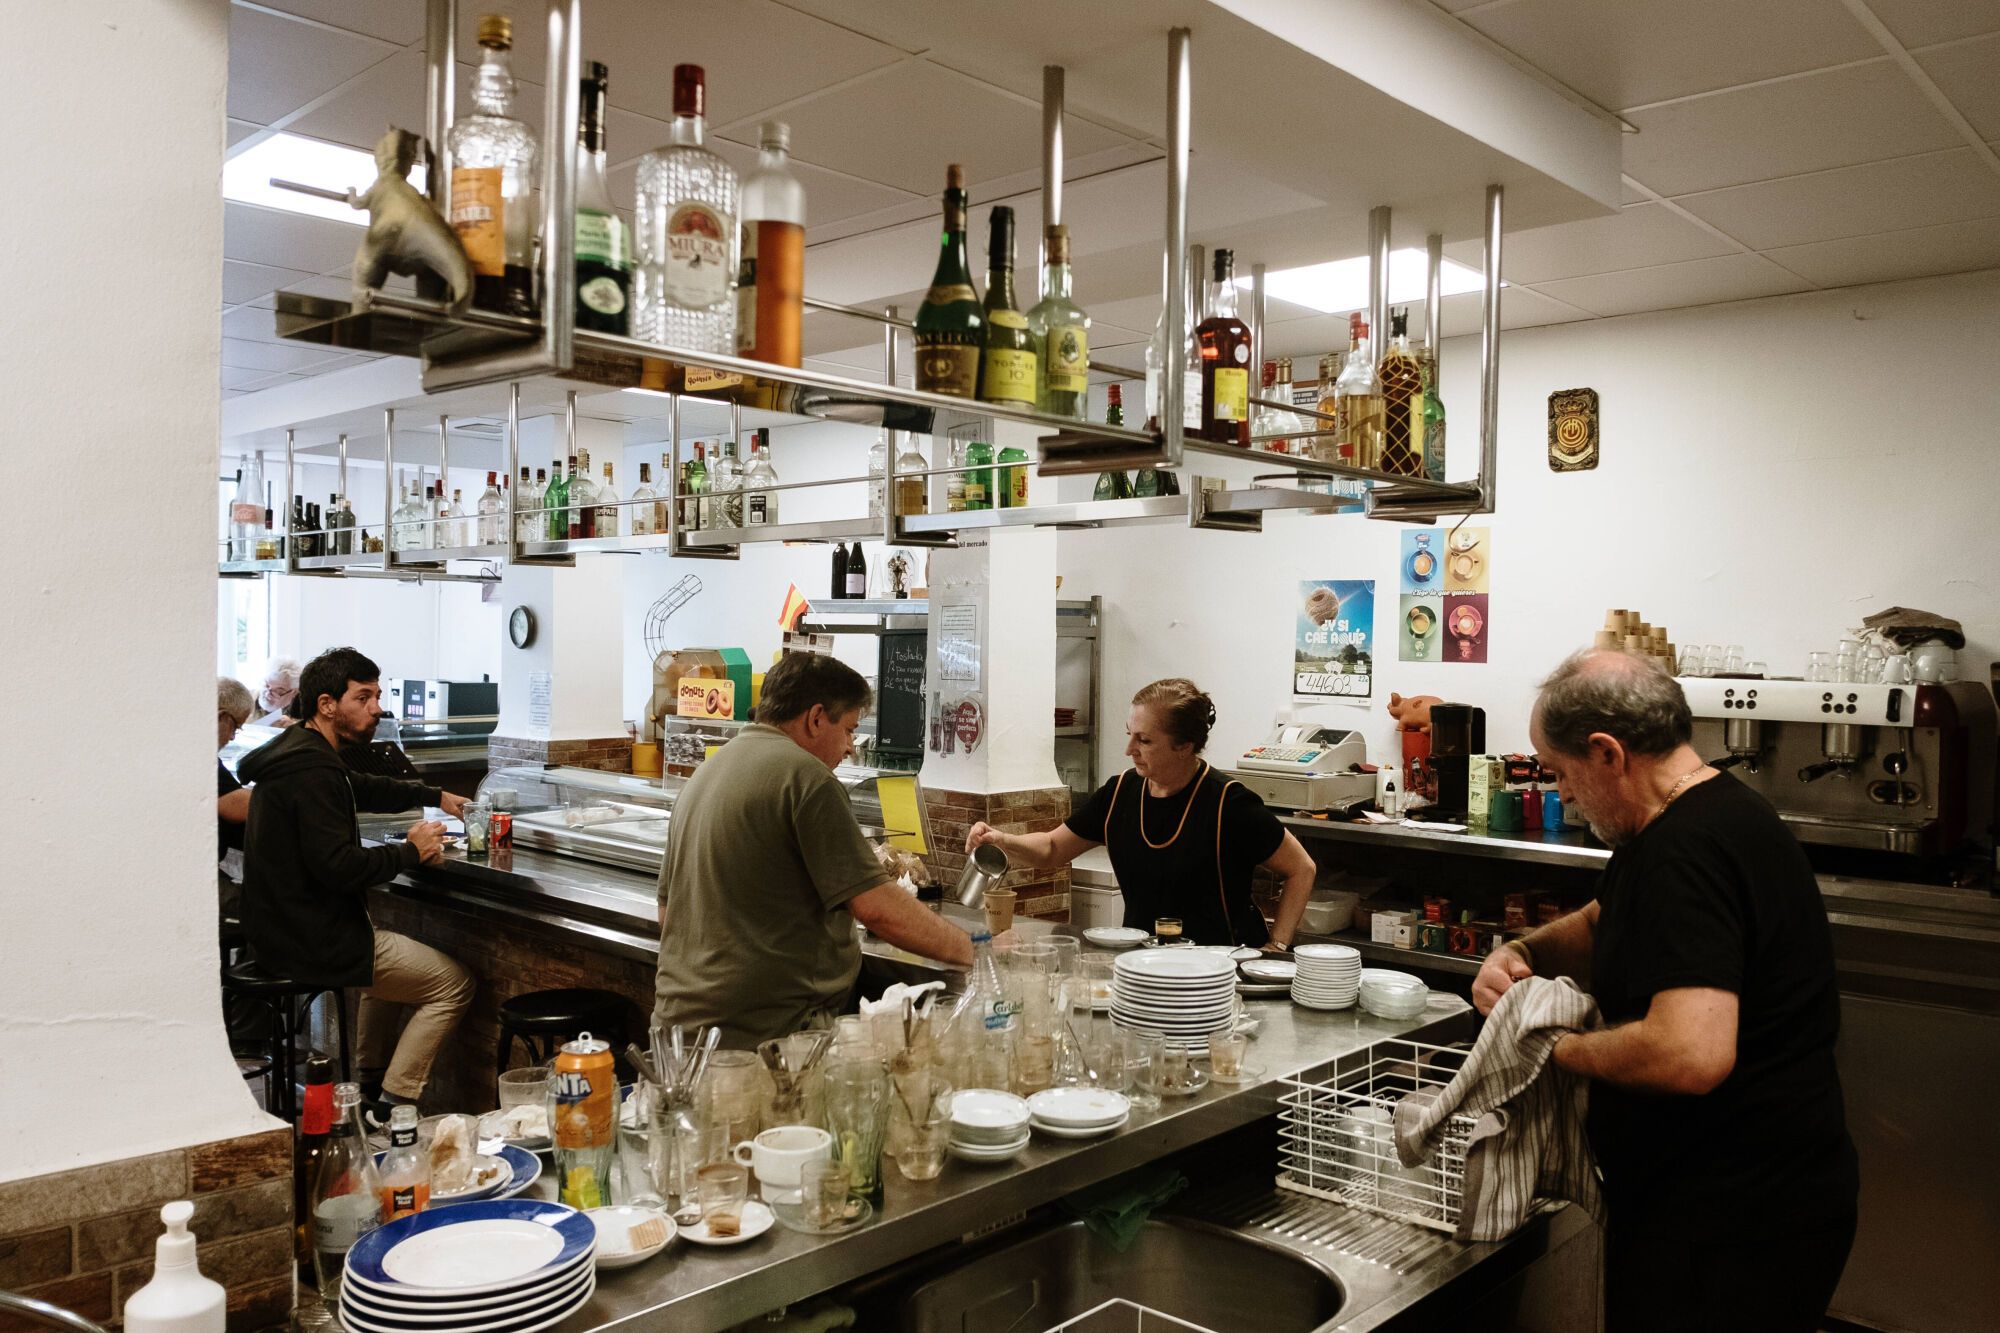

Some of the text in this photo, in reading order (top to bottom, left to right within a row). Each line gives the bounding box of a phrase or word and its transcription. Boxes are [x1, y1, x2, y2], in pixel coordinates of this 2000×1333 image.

[669, 237, 725, 257] MIURA
[1337, 619, 1350, 632] SI
[1304, 632, 1328, 644] CAE
[680, 684, 705, 698] donuts
[1306, 674, 1352, 695] 44603
[556, 1071, 592, 1097] NTA
